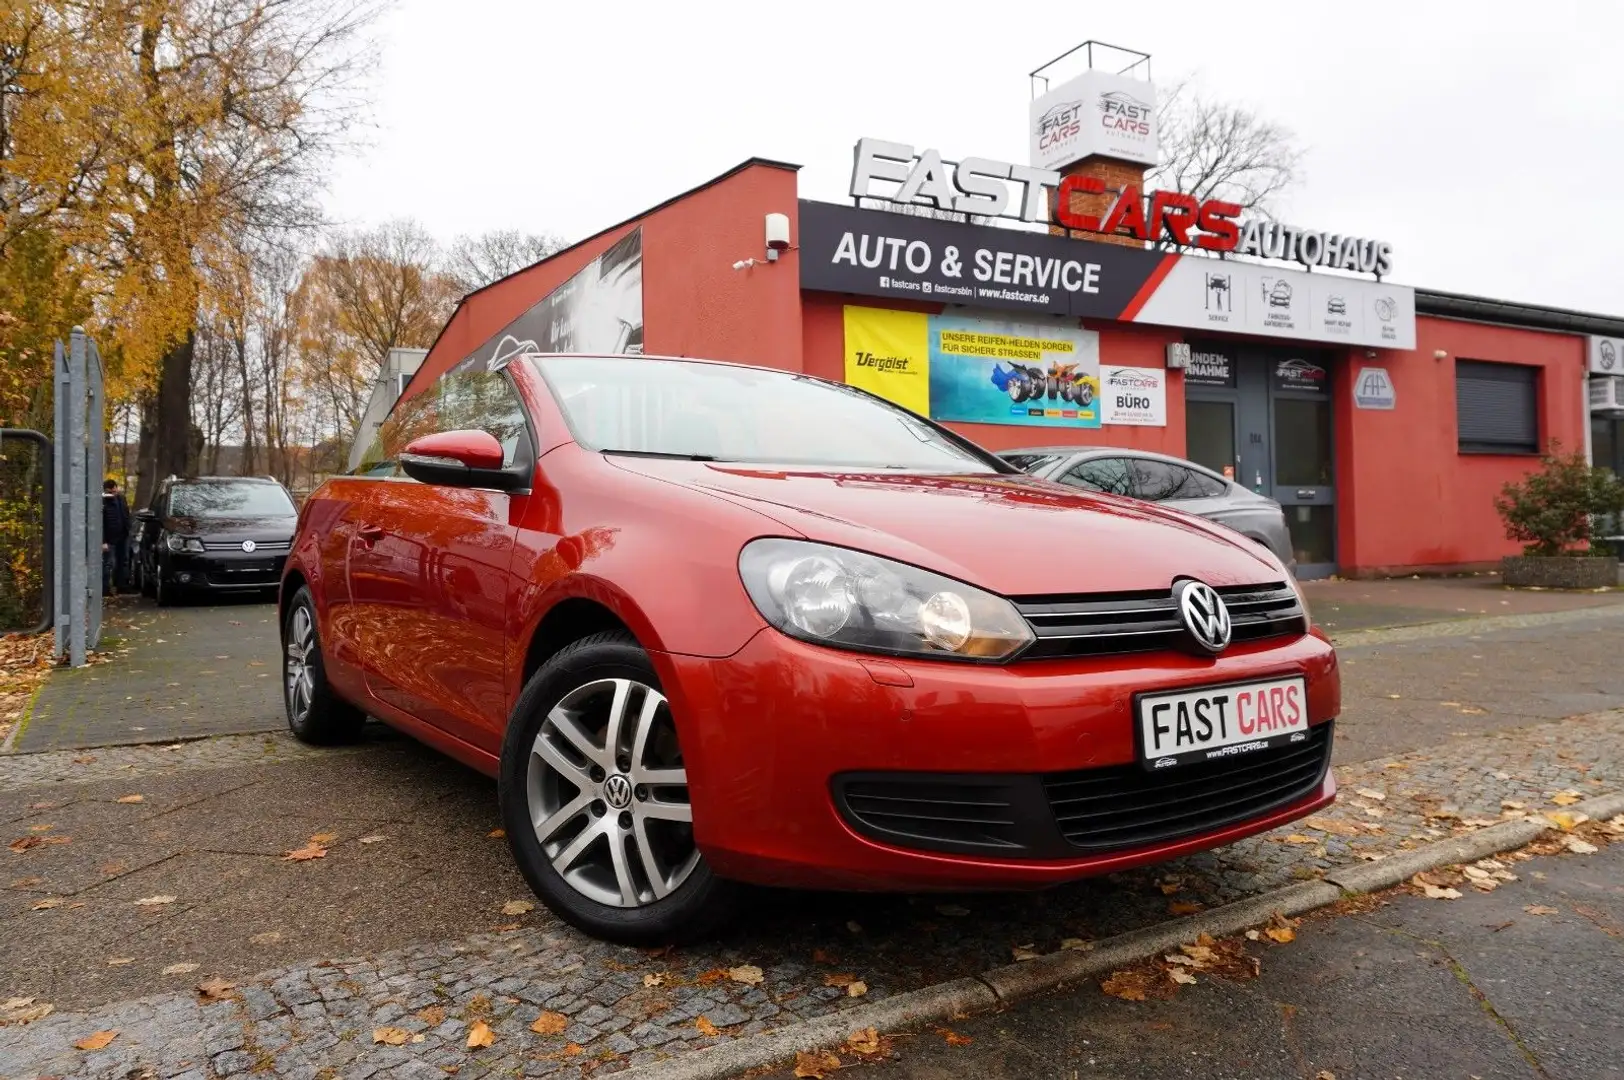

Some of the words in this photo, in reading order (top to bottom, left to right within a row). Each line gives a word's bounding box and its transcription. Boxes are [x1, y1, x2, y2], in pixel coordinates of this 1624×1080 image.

[1037, 104, 1082, 135] FAST
[1099, 99, 1151, 121] FAST
[1039, 119, 1081, 150] CARS
[1101, 114, 1150, 136] CARS
[1237, 218, 1394, 277] AUTOHAUS
[831, 231, 933, 275] AUTO
[940, 245, 963, 278] &
[972, 248, 1102, 294] SERVICE
[891, 278, 921, 291] fastcars
[979, 287, 1051, 305] www.fastcars.de
[942, 332, 976, 344] UNSERE
[977, 335, 1041, 350] REIFEN-HELDEN
[1042, 340, 1073, 352] SORGEN
[961, 345, 997, 356] SICHERE
[998, 348, 1041, 360] STRASSEN!
[855, 352, 909, 372] Vergölst
[1116, 393, 1150, 409] BÜRO
[1151, 695, 1229, 750] FAST
[1236, 685, 1300, 735] CARS
